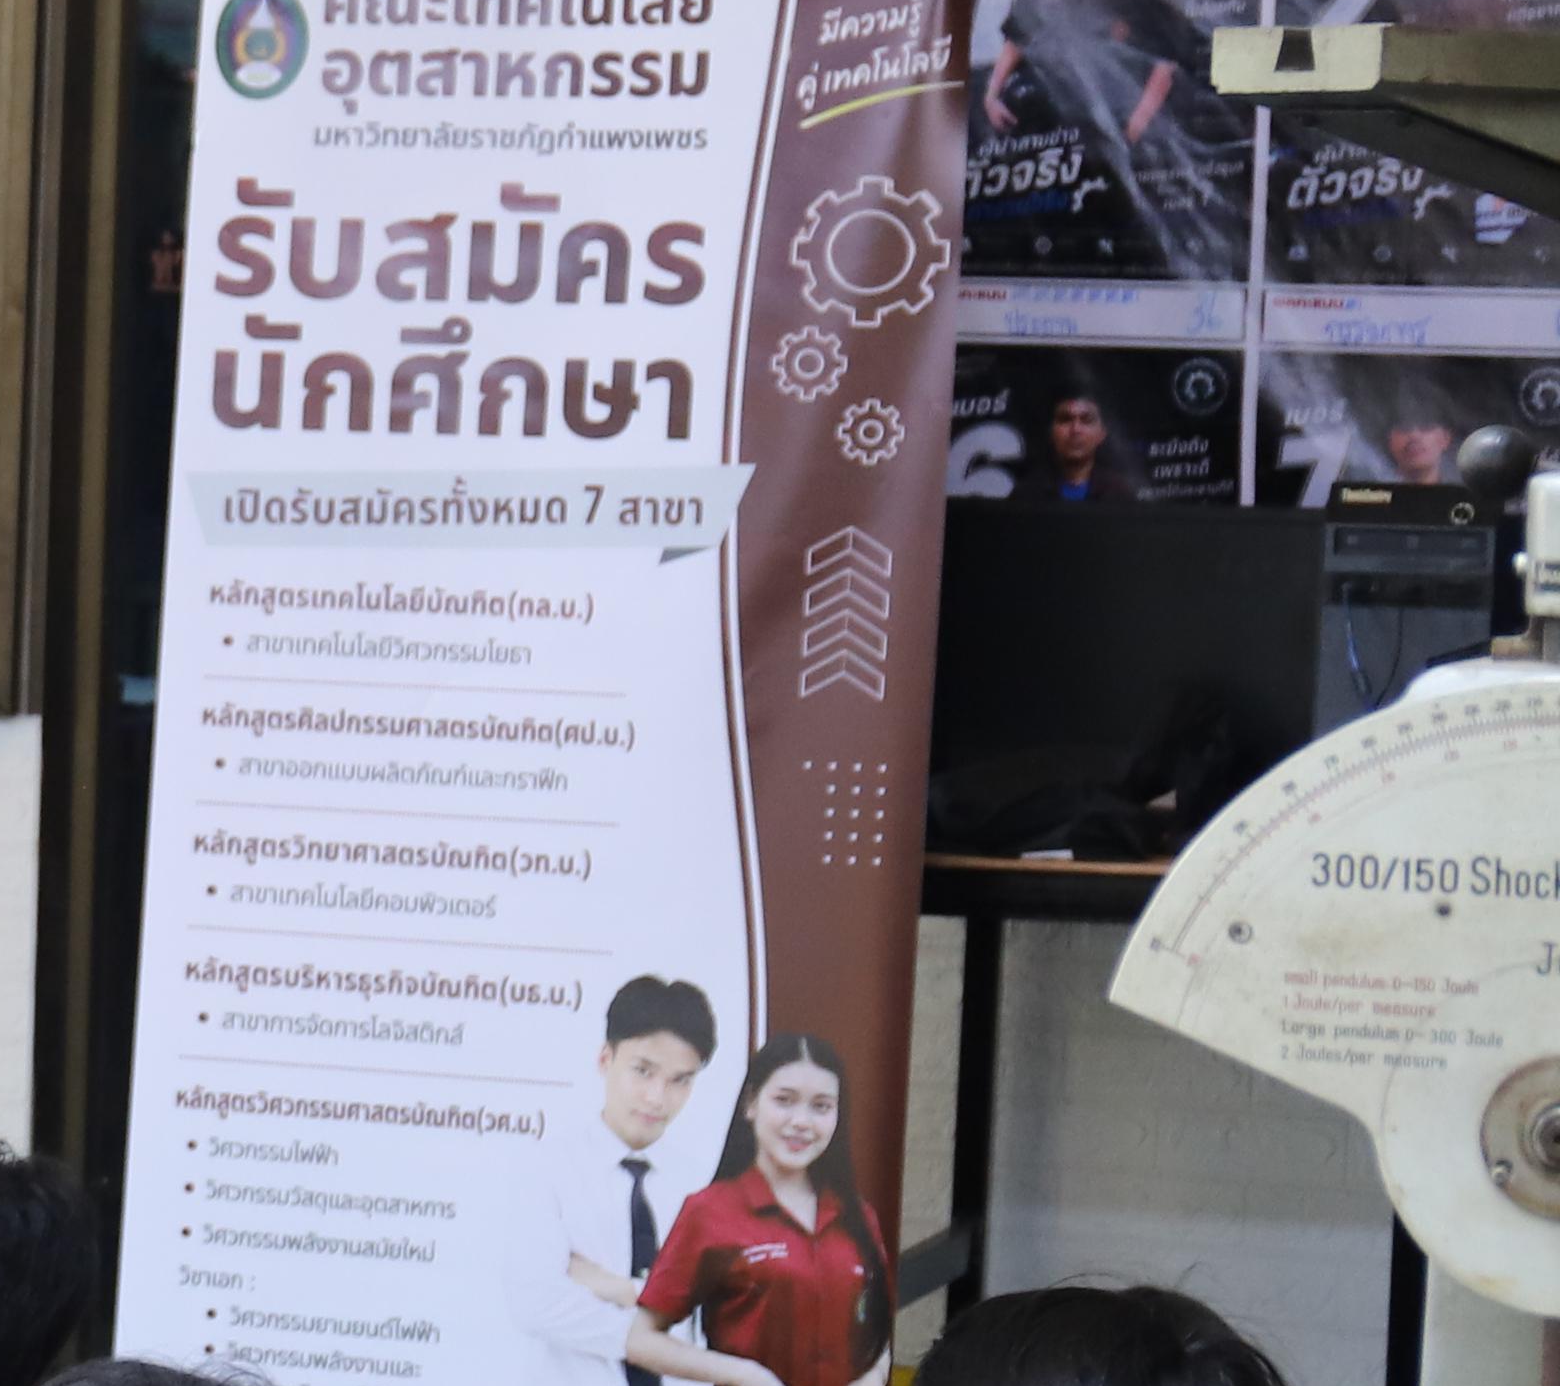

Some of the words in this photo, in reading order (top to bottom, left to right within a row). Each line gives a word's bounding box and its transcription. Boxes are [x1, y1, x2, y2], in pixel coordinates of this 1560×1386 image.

[321, 48, 709, 117] อุตสาหกรรม
[214, 177, 707, 305] รับสมัคร
[210, 315, 695, 440] นักศึกษา
[225, 485, 567, 527] เปิดรับสมัครทั้งหมด
[585, 486, 602, 524] 7
[618, 491, 705, 527] สาขา
[1310, 852, 1460, 894] 300/150
